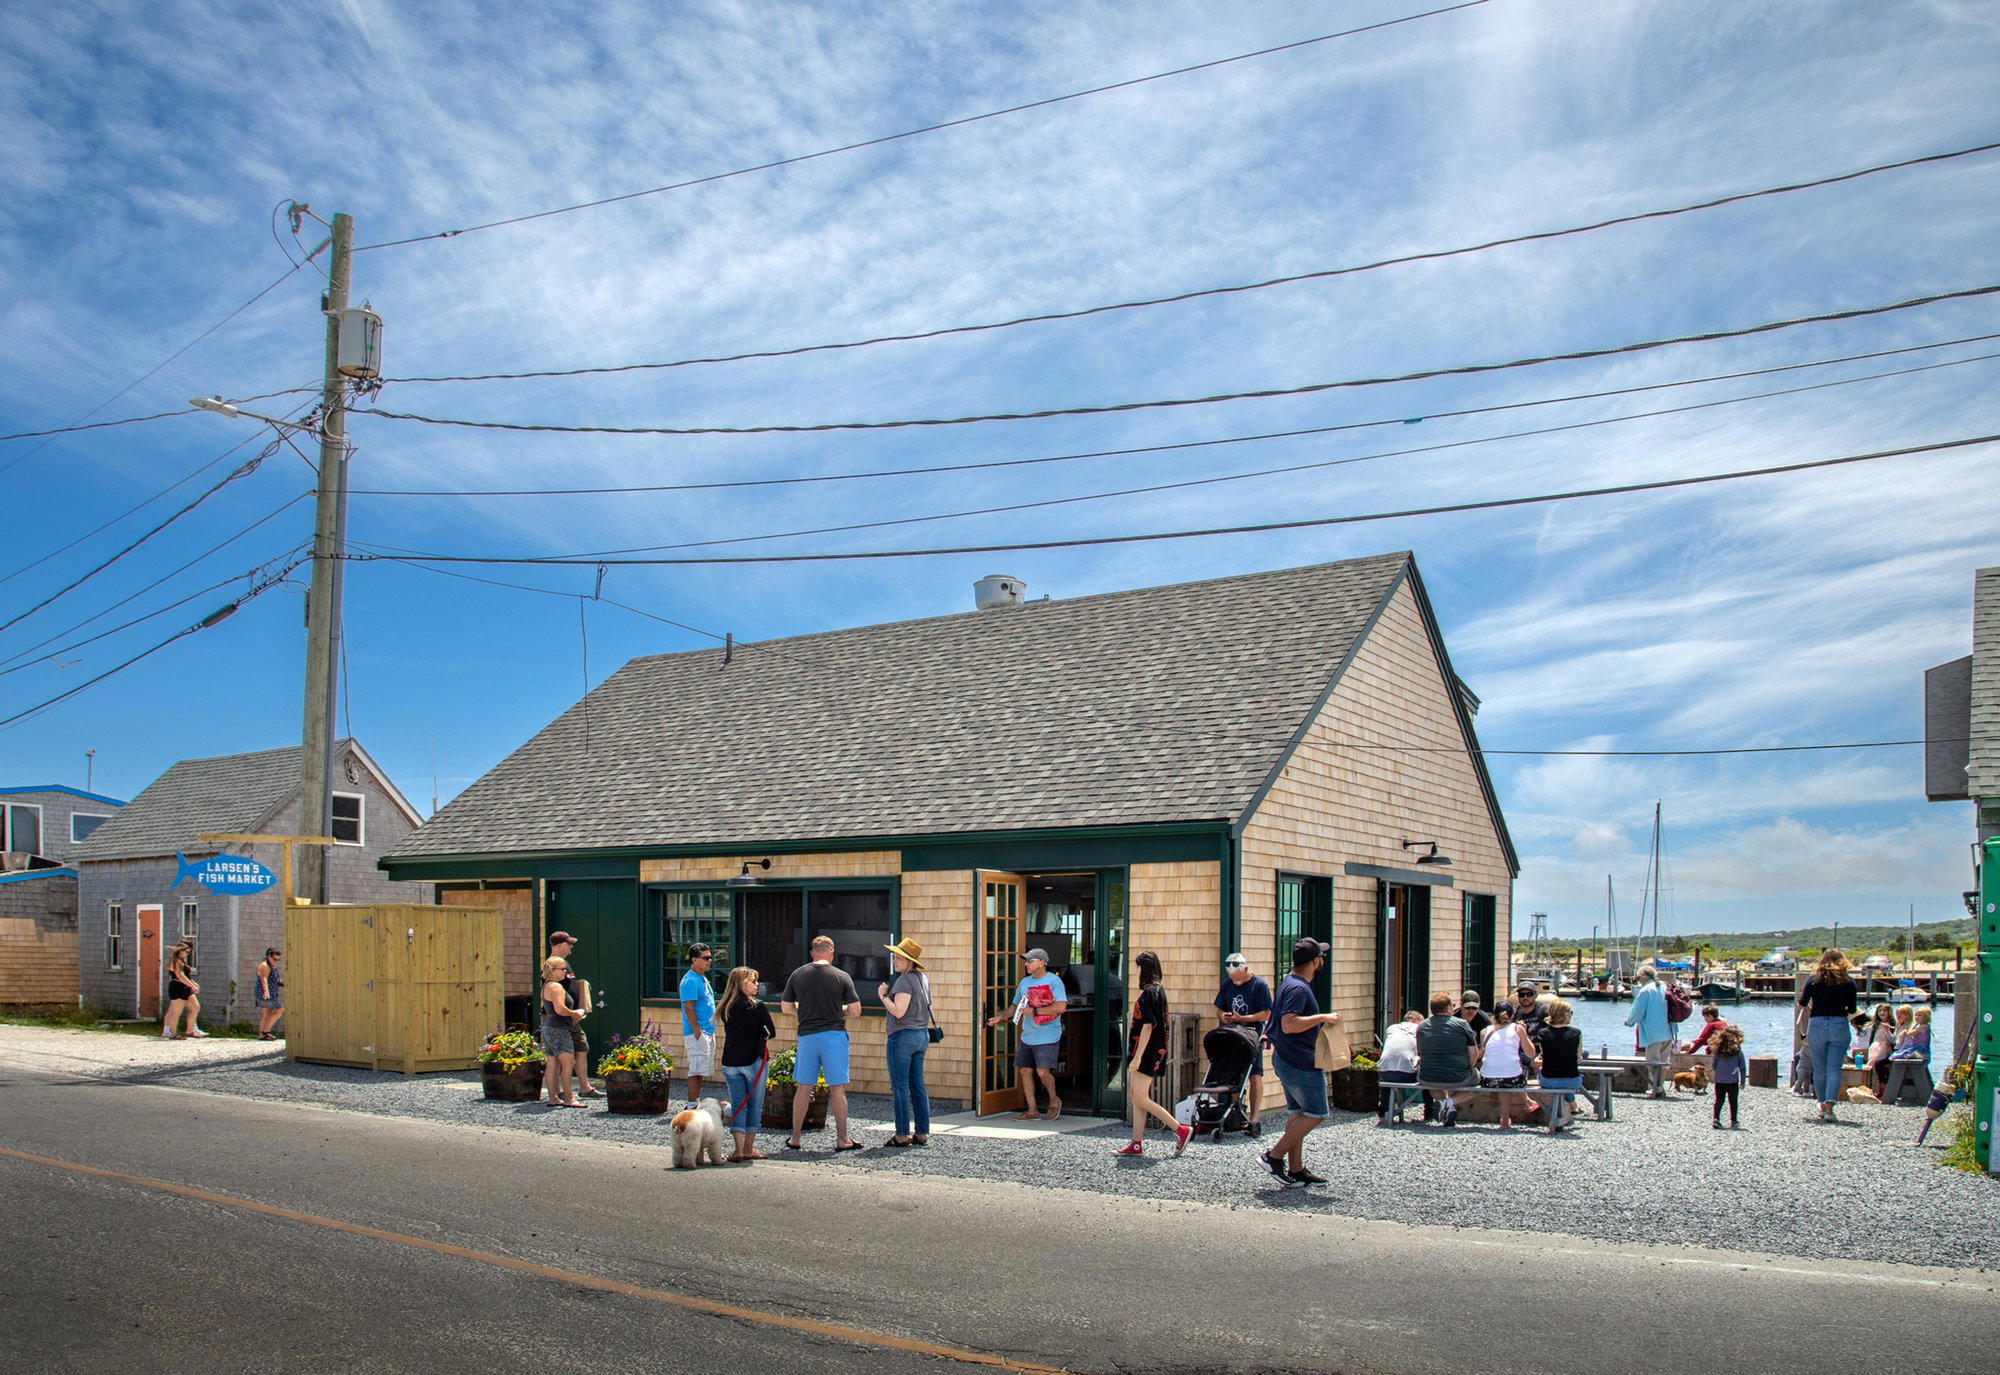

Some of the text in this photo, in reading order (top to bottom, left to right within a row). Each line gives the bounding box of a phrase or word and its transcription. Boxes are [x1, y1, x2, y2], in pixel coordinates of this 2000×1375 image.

[207, 862, 260, 873] LARSEN'S
[198, 873, 272, 885] FISH MARKET
